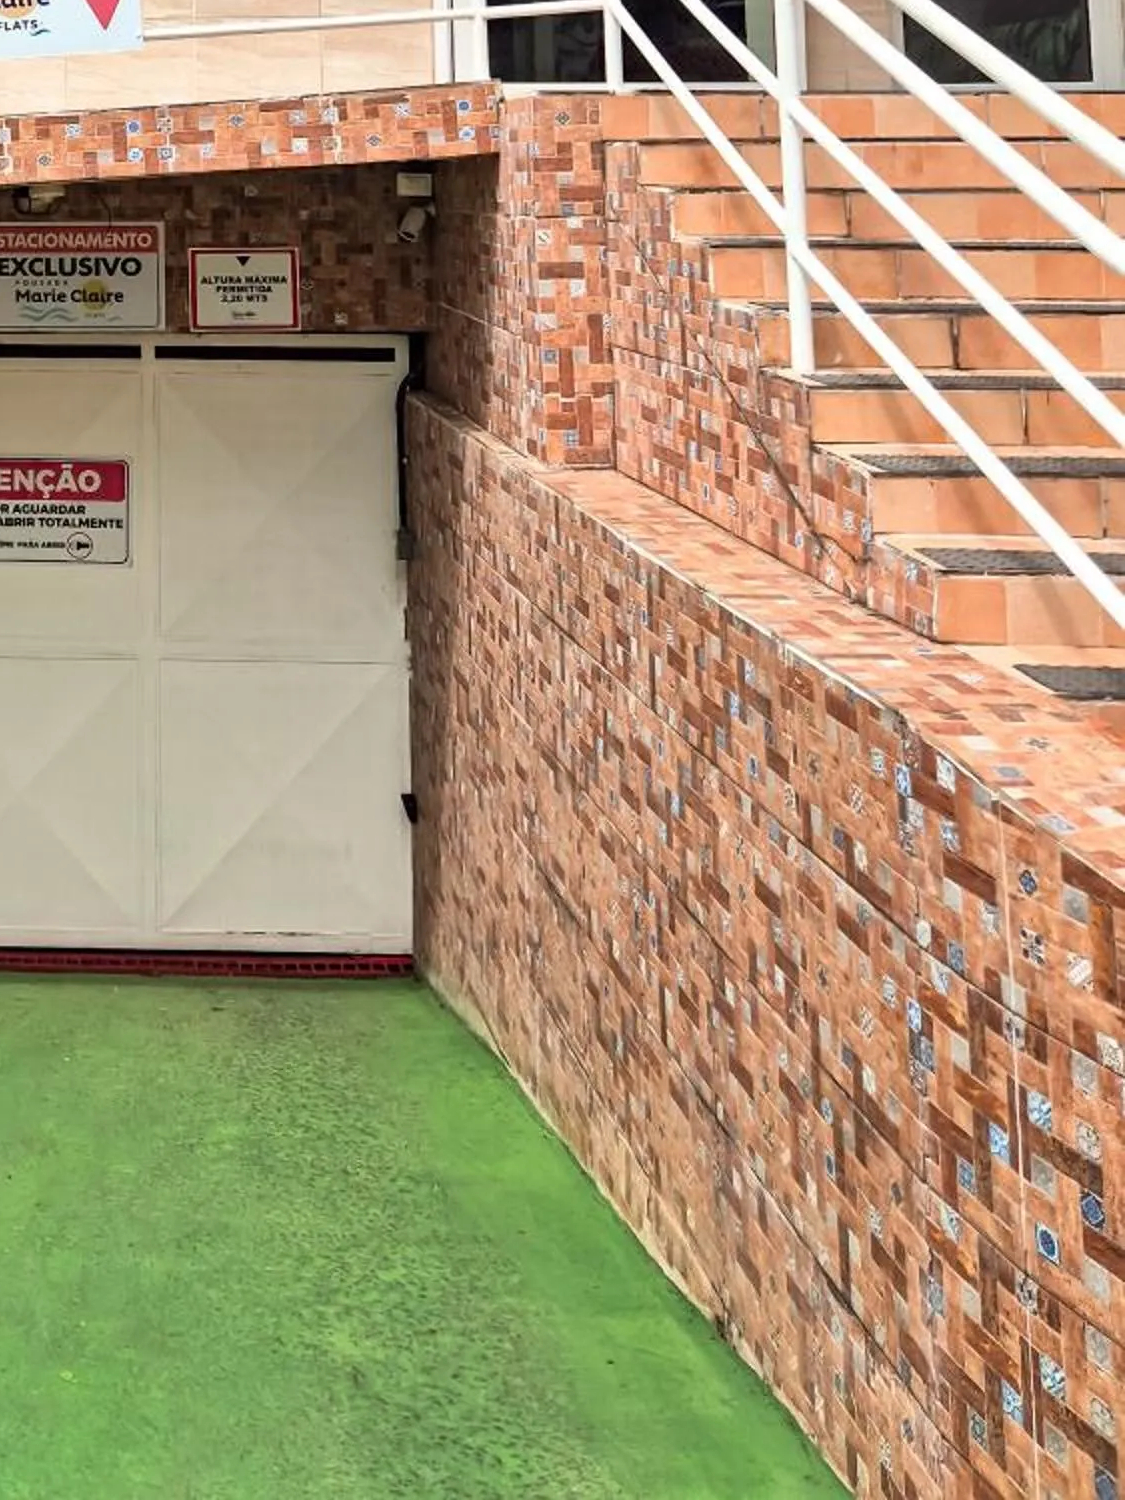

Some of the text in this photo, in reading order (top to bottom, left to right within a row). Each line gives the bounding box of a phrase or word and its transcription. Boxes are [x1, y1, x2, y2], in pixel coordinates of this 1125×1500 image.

[14, 288, 125, 304] Marie Claire
[12, 503, 86, 515] AGUARDAR
[37, 517, 124, 529] TOTALMENTE
